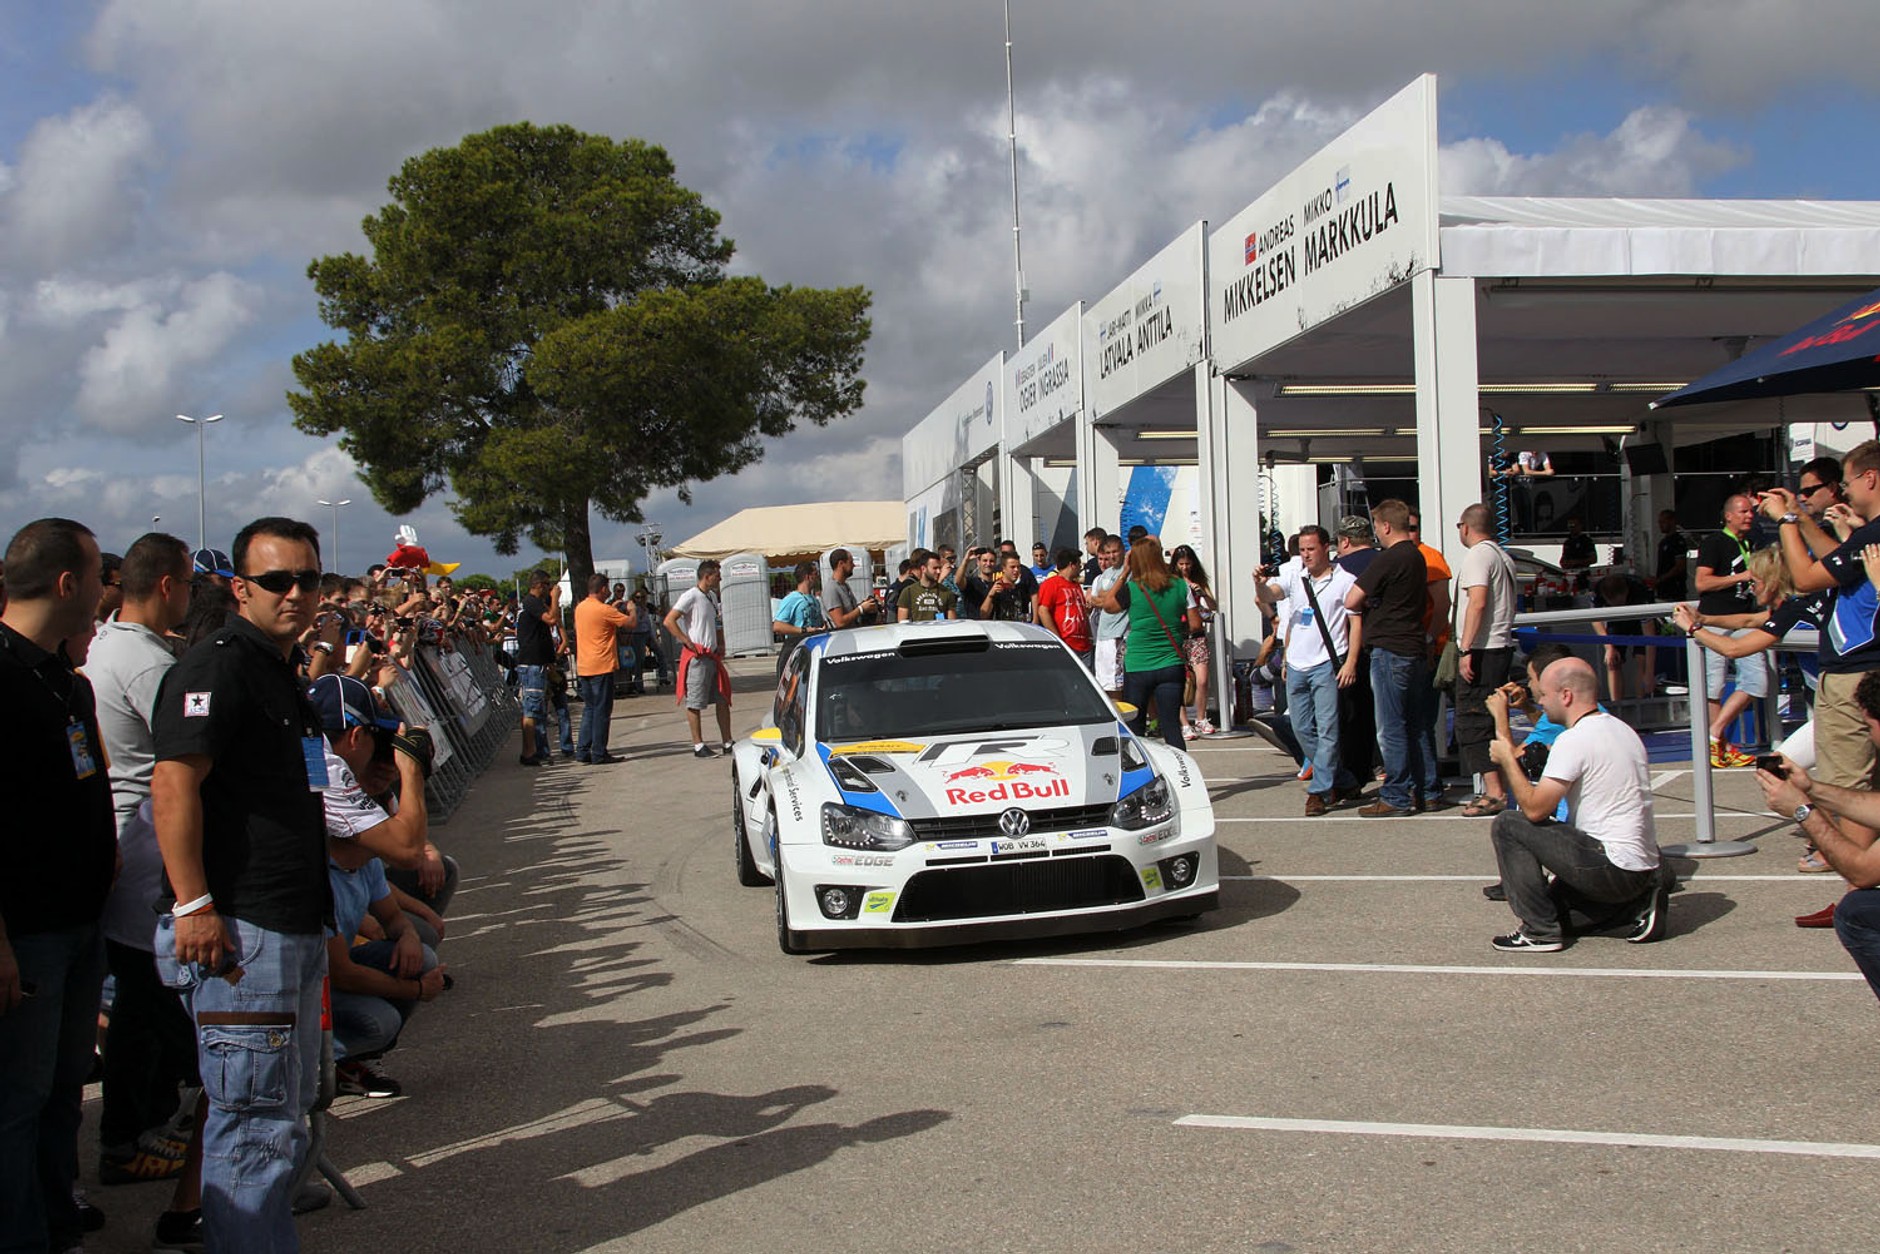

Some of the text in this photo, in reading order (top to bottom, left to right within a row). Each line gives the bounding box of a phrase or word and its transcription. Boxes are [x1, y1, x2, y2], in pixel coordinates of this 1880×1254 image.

[1259, 188, 1332, 257] ANDREAS MIKKO
[1224, 182, 1398, 324] MIKKELSEN MARKKULA
[1100, 305, 1173, 380] LATVALA ANTTILA
[826, 652, 895, 665] Volkswagen
[995, 642, 1061, 651] Volkswagen
[946, 779, 1070, 805] Red Bull
[854, 855, 895, 867] EDGE
